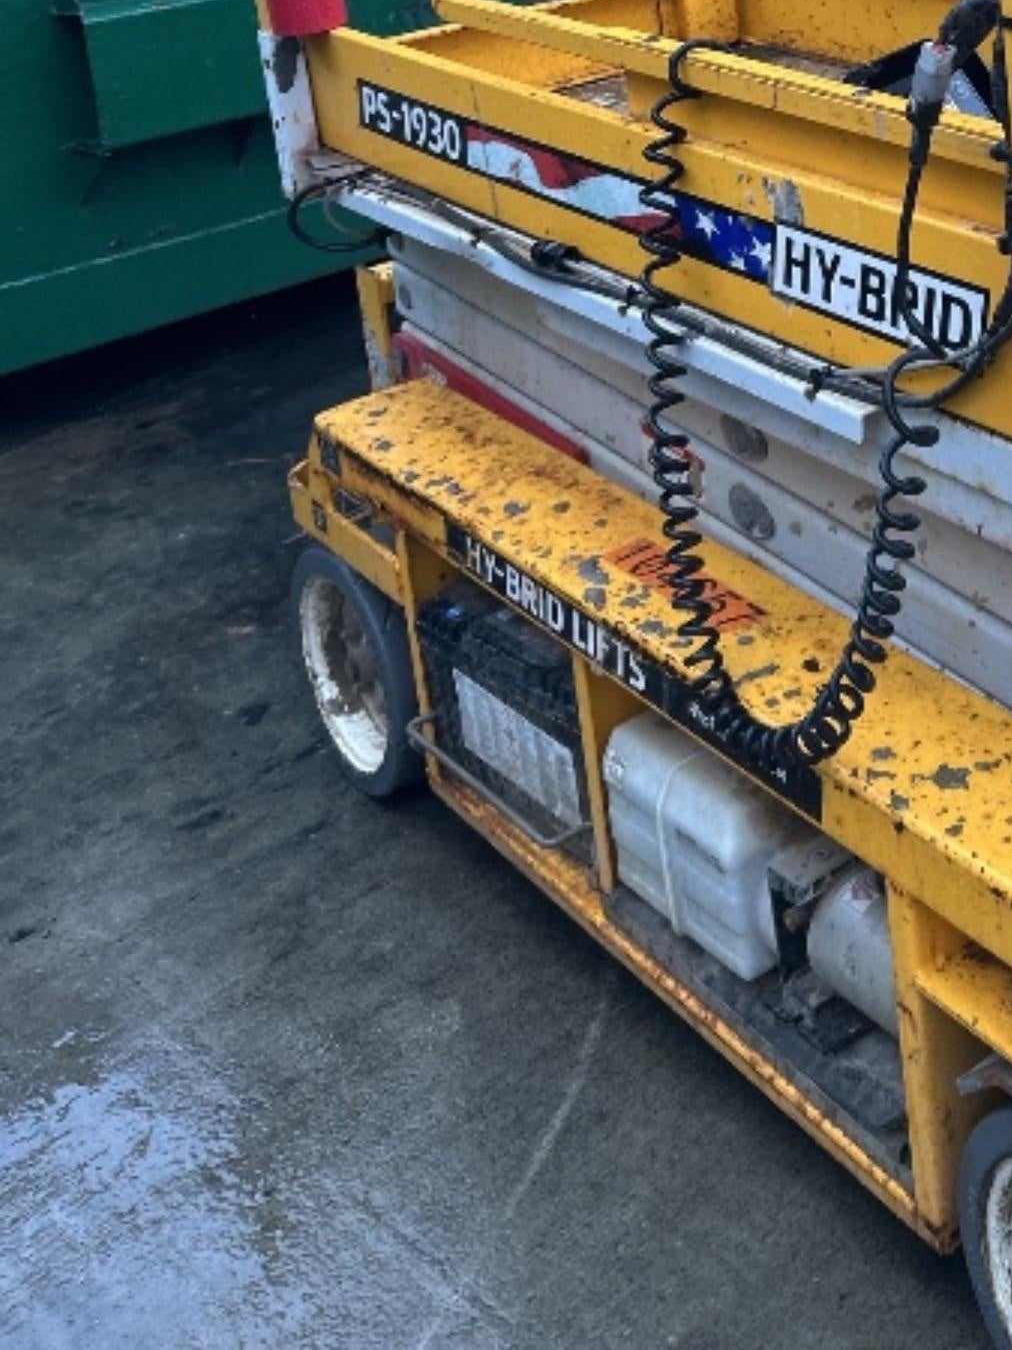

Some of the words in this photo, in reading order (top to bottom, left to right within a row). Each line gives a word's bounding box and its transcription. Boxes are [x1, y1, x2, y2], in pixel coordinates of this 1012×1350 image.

[362, 86, 459, 159] PS-1930
[784, 236, 972, 350] HY-BRID
[466, 536, 564, 632] HY-BRID
[572, 608, 646, 691] LIFTS
